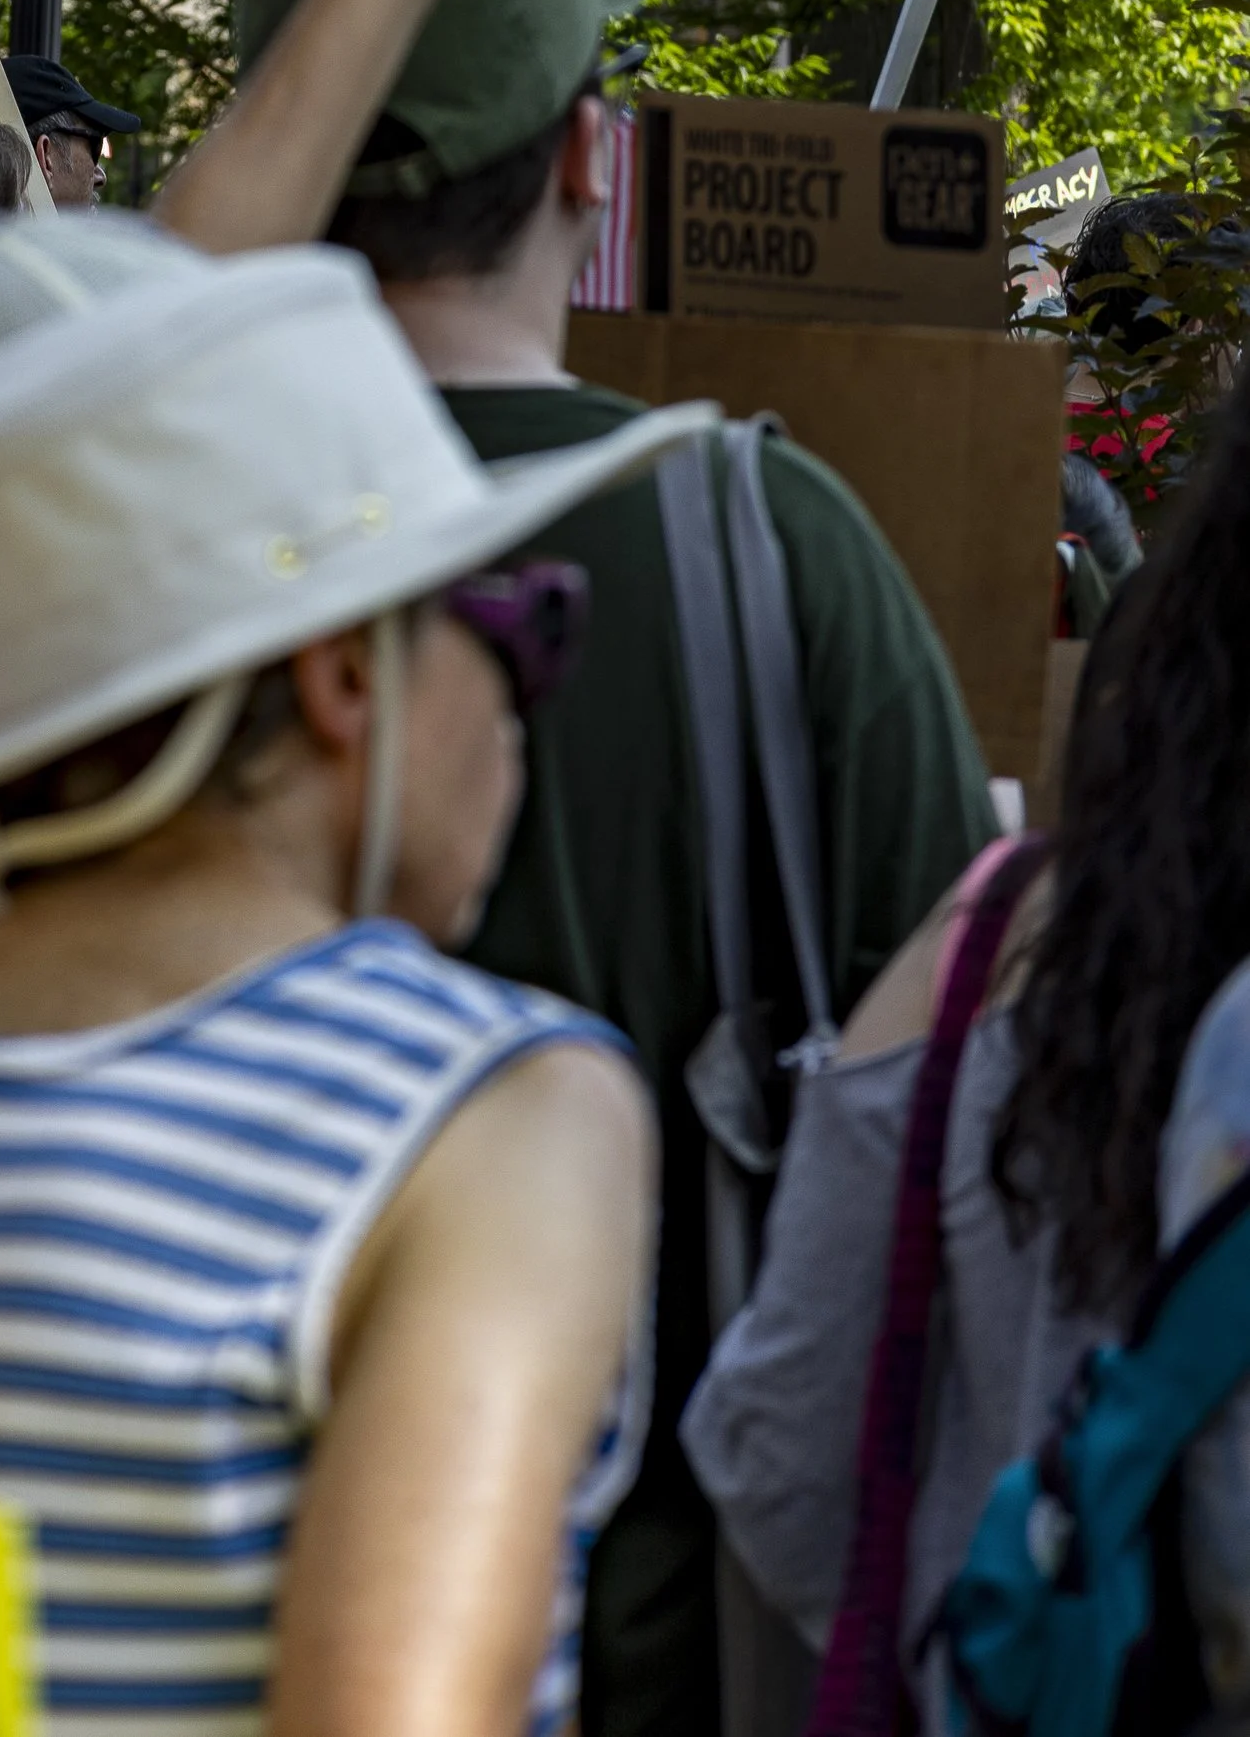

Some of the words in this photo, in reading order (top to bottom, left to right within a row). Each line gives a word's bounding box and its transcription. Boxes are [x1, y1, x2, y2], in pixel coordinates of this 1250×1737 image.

[683, 158, 847, 221] PROJECT
[1005, 165, 1099, 219] MOCRACY
[683, 217, 817, 277] BOARD
